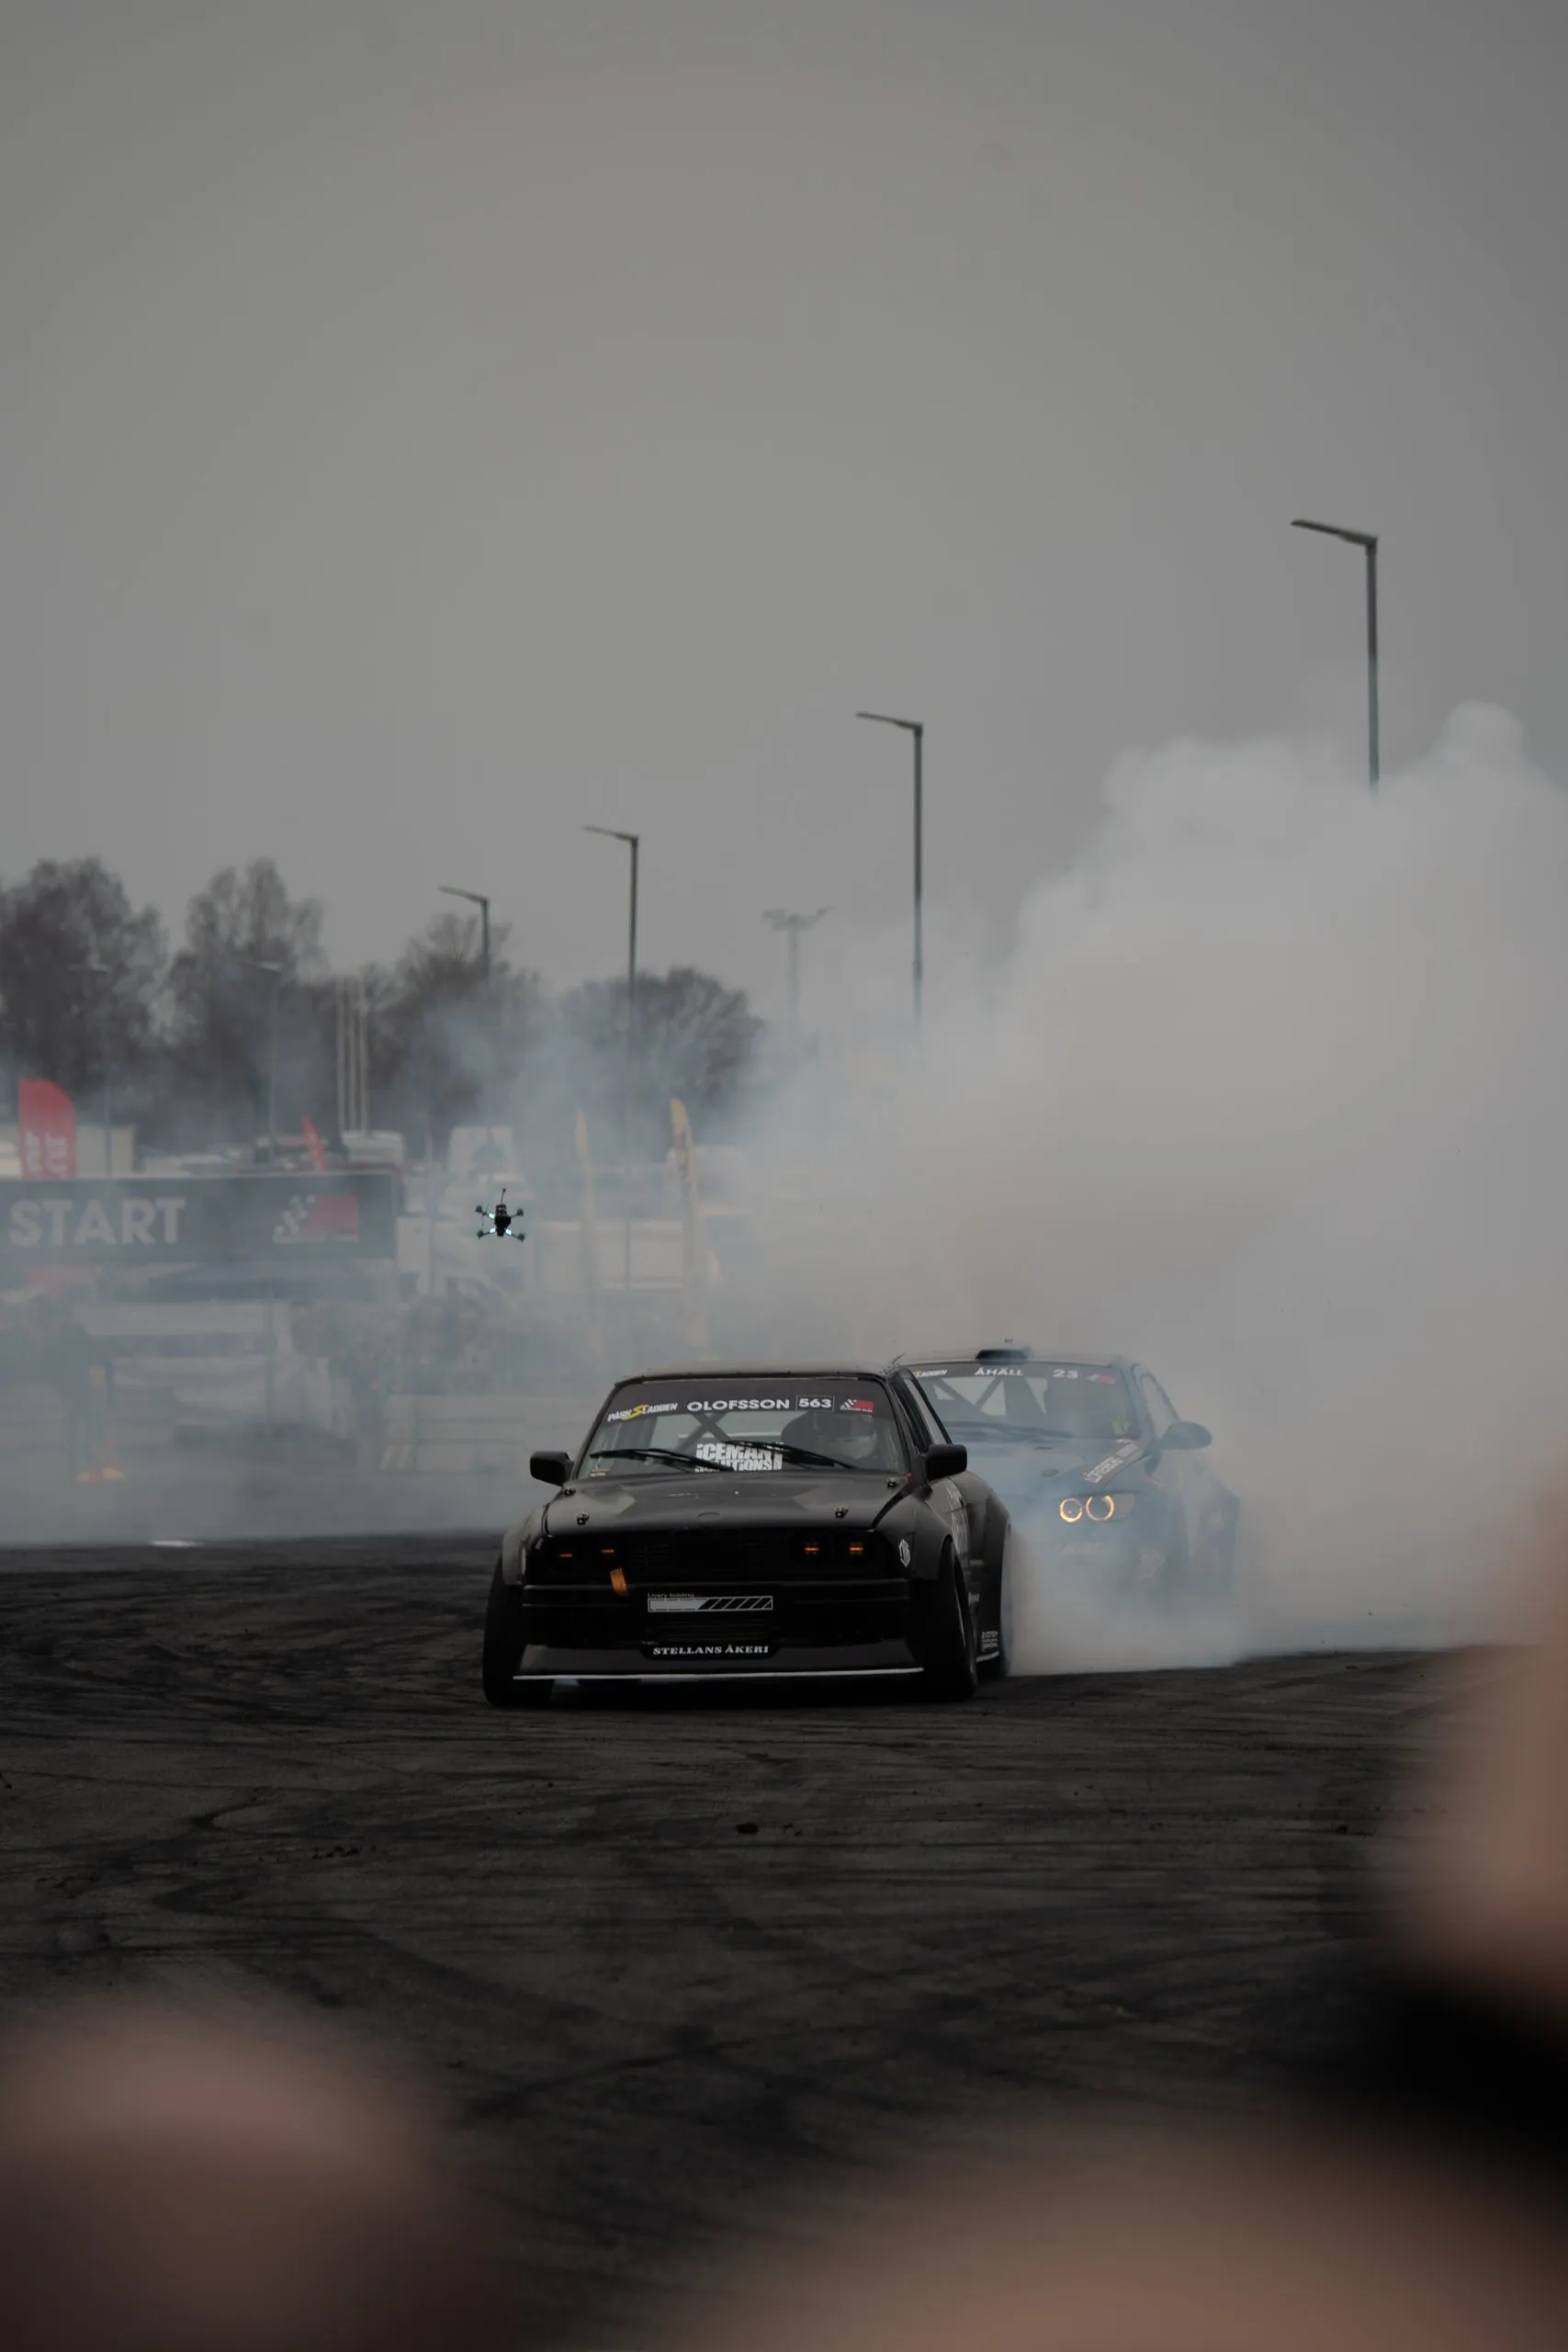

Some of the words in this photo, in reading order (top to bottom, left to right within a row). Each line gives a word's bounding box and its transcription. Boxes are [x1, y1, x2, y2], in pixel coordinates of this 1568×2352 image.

[8, 1198, 186, 1248] START
[1052, 1368, 1078, 1379] 23
[687, 1399, 790, 1412] OLOFSSON
[798, 1397, 832, 1408] 563
[653, 1645, 723, 1655] STELLANS
[725, 1644, 769, 1654] ÅKERI
